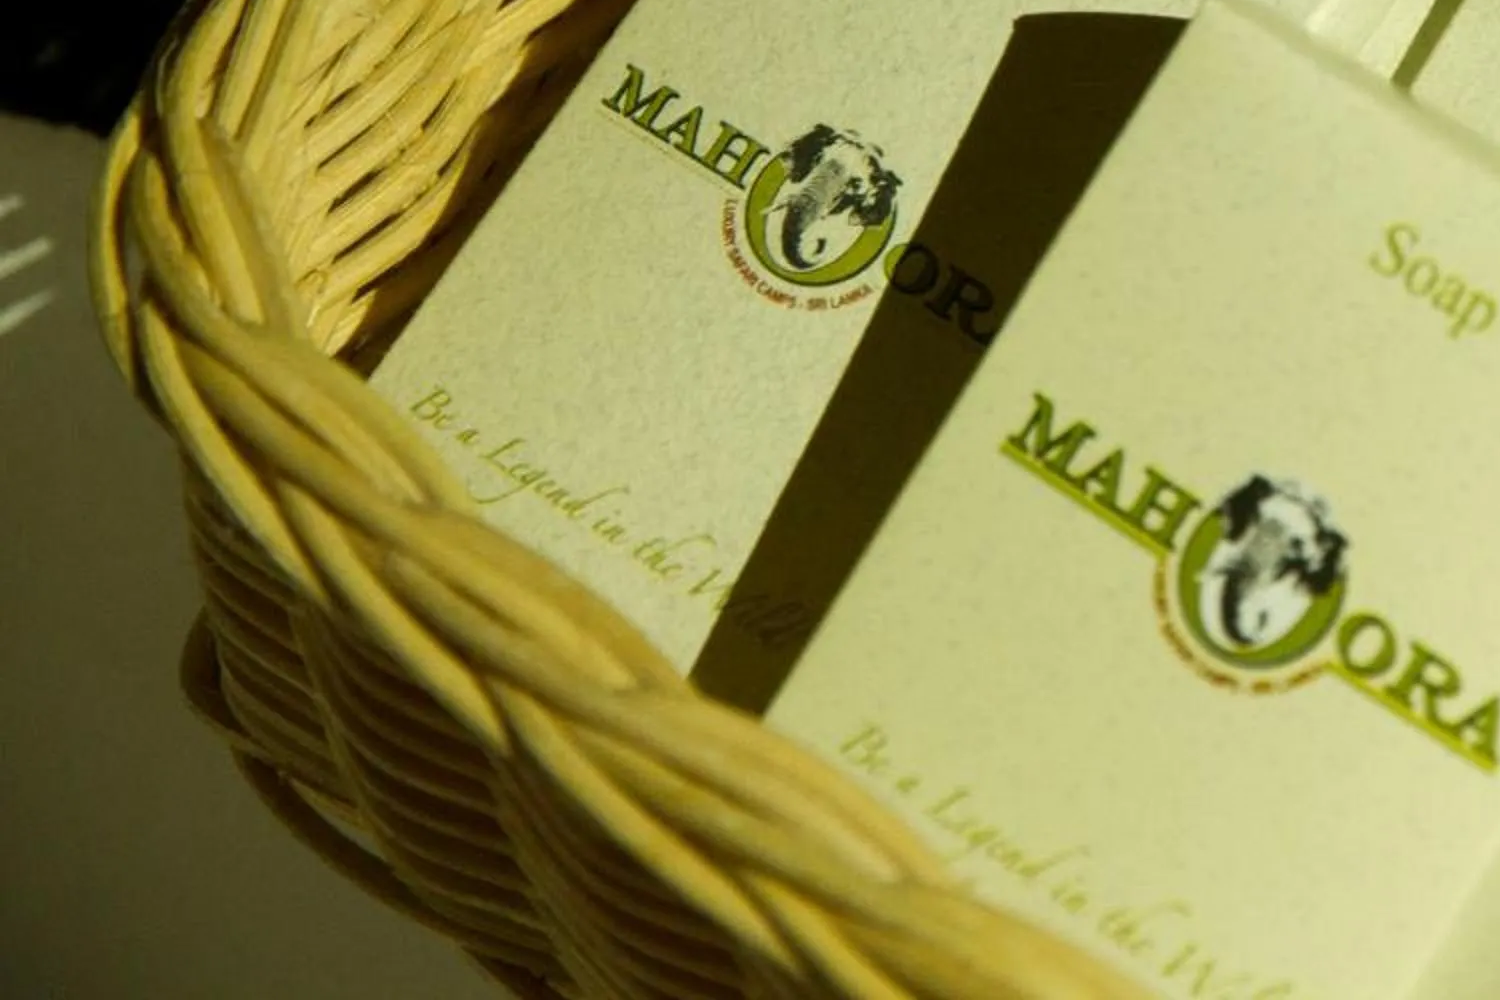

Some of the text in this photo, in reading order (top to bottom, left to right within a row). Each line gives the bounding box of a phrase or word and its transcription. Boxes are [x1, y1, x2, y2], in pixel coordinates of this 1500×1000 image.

[600, 63, 997, 347] MAHOOR
[1369, 220, 1498, 340] Soap
[467, 437, 631, 504] Legend
